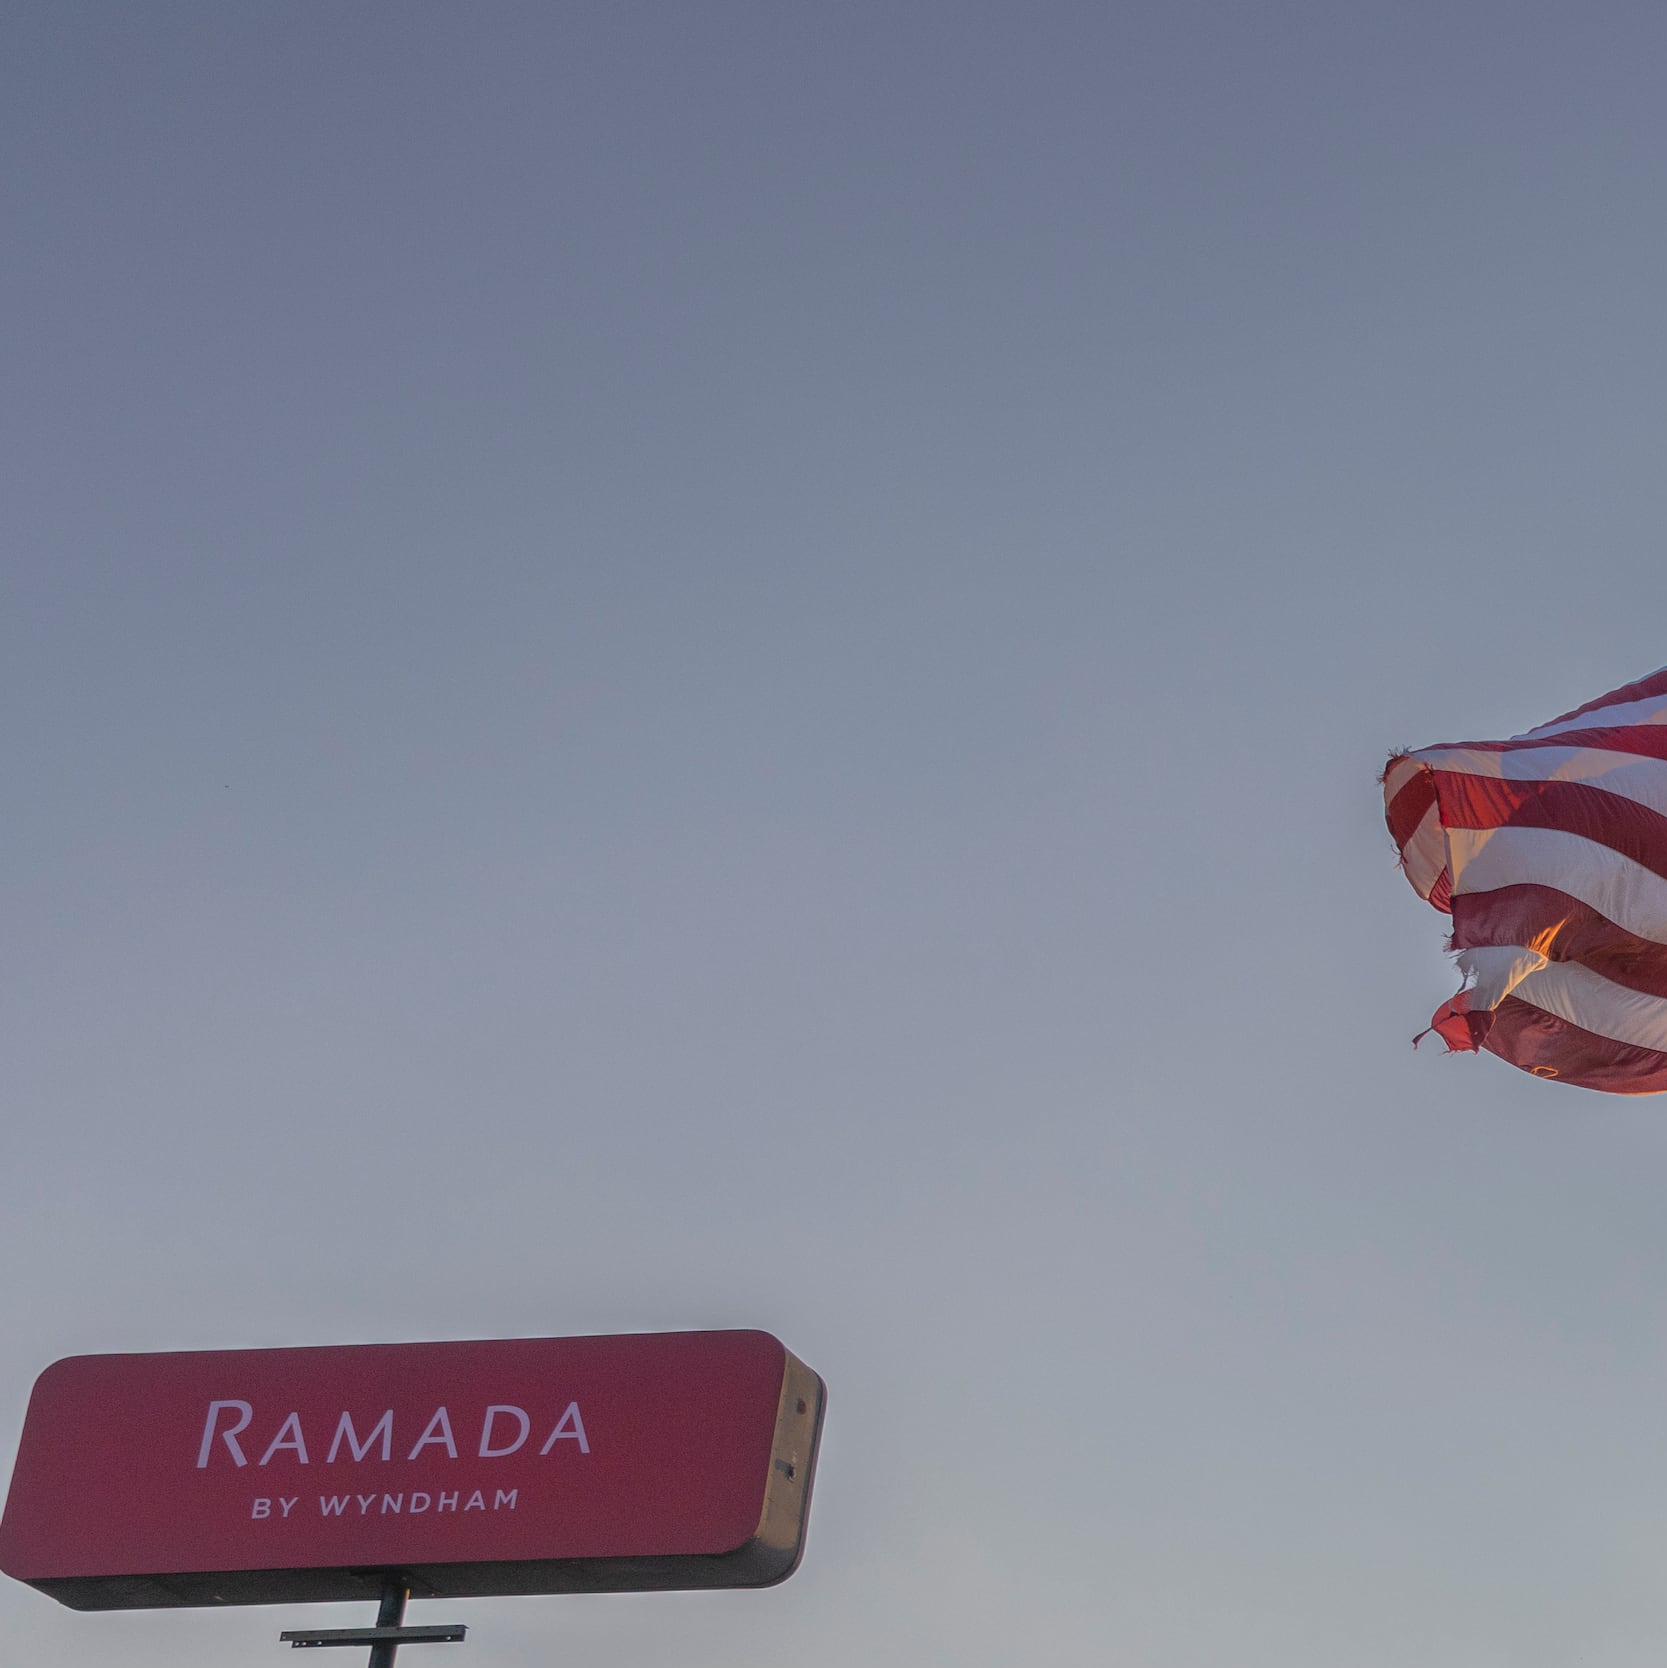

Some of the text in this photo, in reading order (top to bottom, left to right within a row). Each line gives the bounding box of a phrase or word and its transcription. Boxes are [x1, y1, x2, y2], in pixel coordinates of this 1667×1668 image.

[196, 1400, 592, 1469] RAMADA
[251, 1488, 519, 1519] BY WYNDHAM
